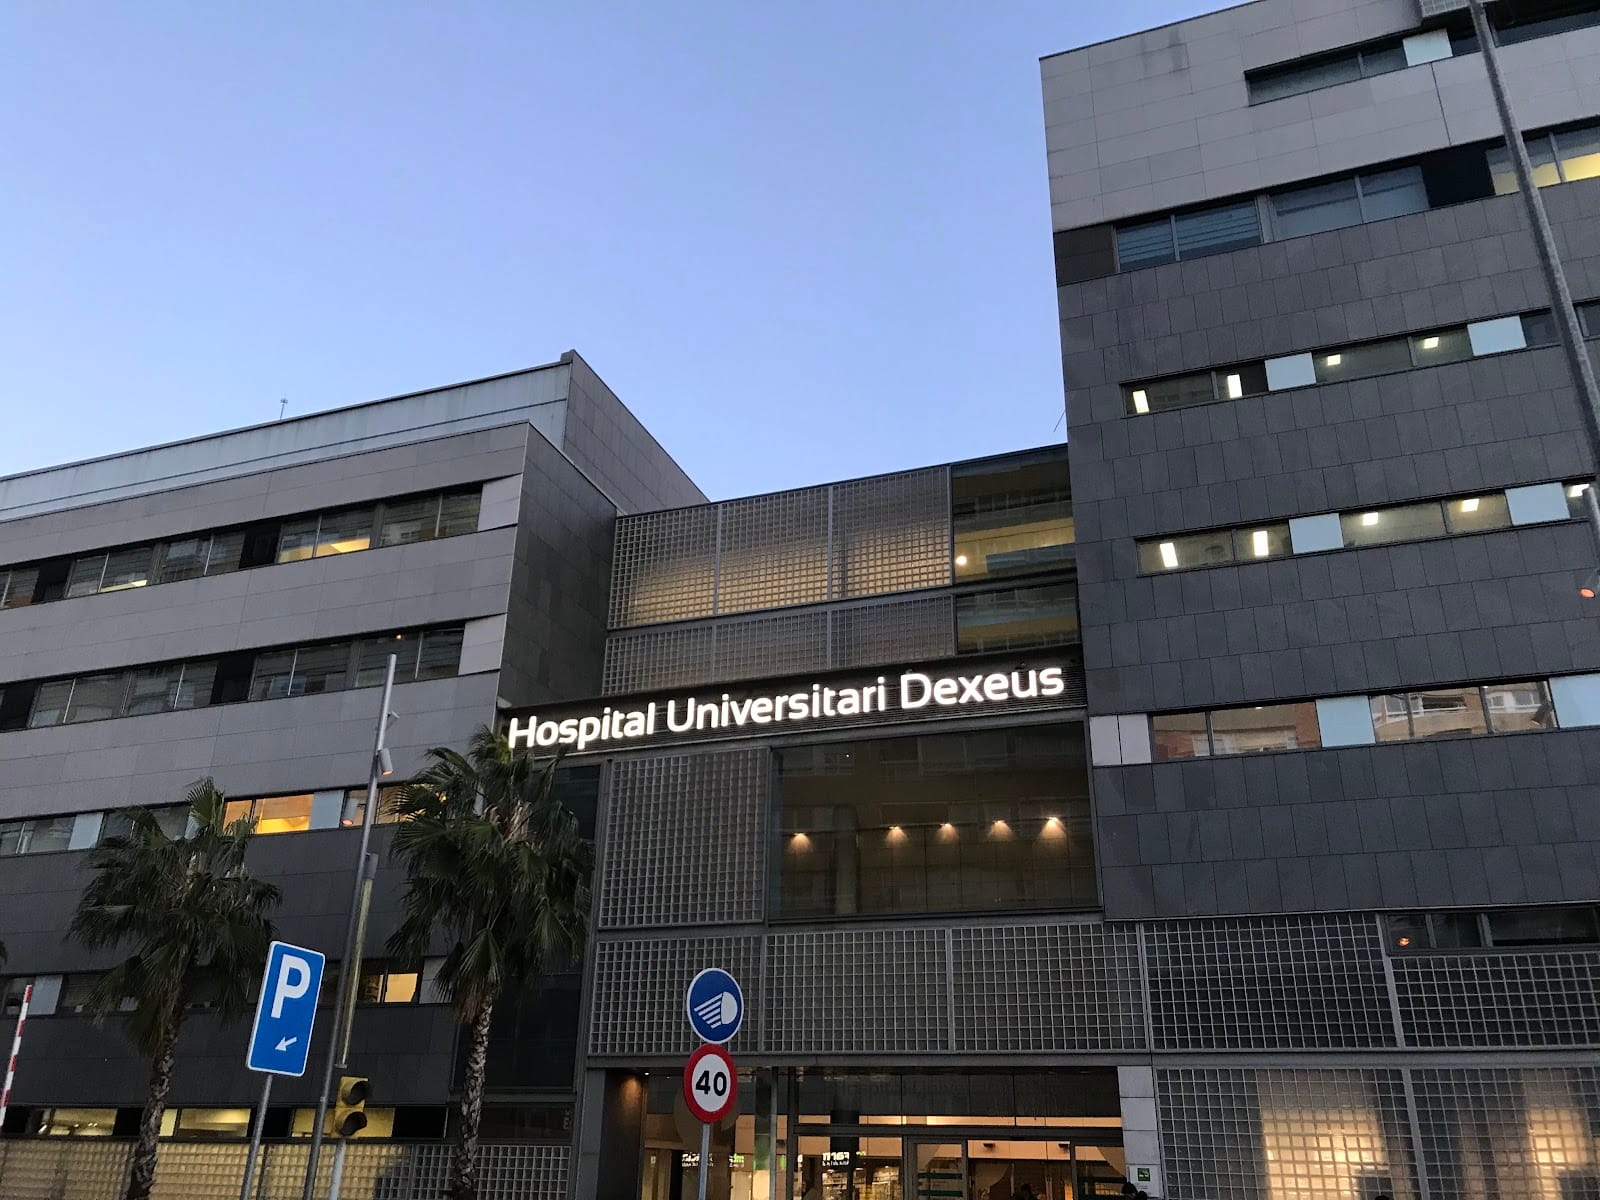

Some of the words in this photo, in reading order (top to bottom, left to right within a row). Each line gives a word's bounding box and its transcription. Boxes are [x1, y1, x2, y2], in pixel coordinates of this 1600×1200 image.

[508, 702, 656, 750] Hospital
[666, 677, 887, 733] Universitari
[900, 667, 1065, 710] Dexeus
[271, 954, 311, 1019] P
[695, 1070, 728, 1097] 40
